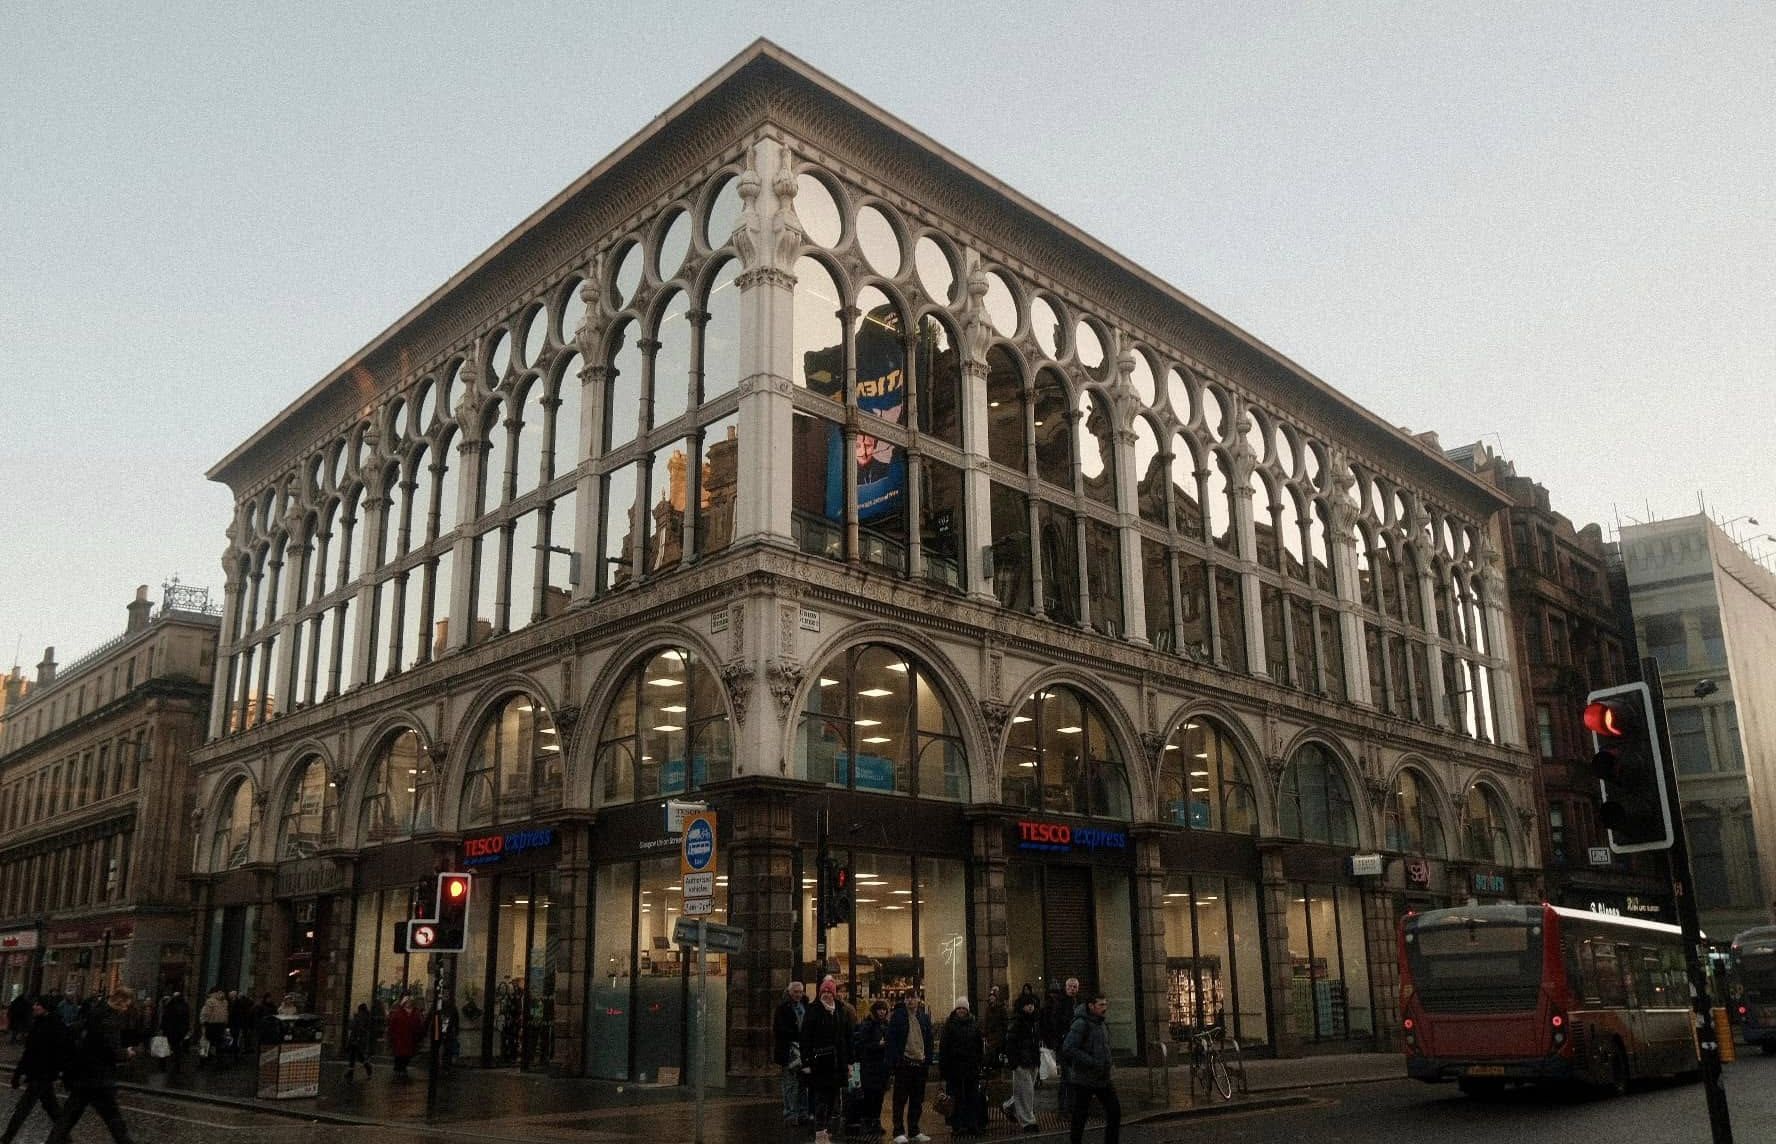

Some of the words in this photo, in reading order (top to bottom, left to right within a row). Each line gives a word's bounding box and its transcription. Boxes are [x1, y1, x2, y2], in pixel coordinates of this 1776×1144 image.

[464, 836, 504, 857] TESCO
[505, 829, 553, 854] express
[1018, 820, 1071, 845] TESCO
[1073, 827, 1128, 852] express
